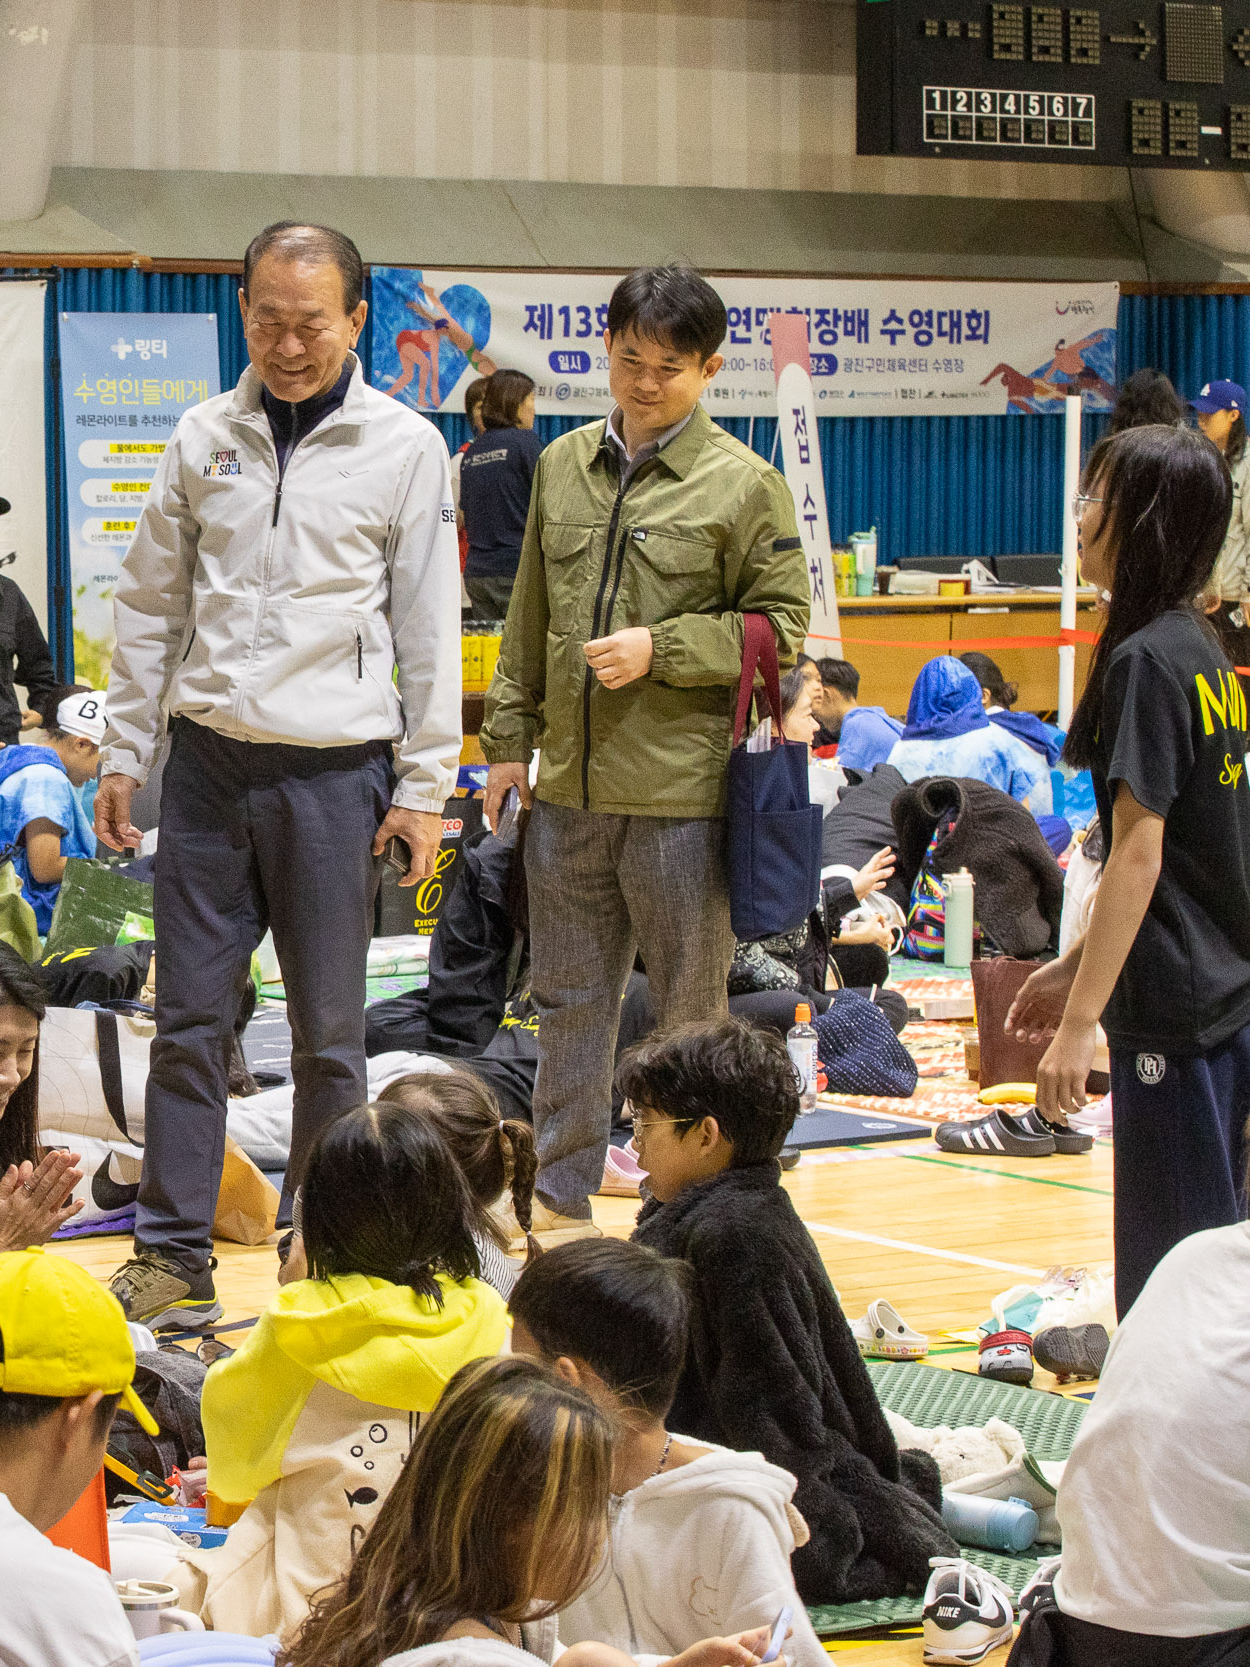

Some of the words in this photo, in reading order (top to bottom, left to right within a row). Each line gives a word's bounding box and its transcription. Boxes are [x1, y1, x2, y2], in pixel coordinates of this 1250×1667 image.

[931, 90, 942, 111] 1
[955, 92, 968, 112] 2
[979, 93, 993, 113] 3
[1003, 94, 1017, 115] 4
[1028, 96, 1040, 116] 5
[1052, 97, 1064, 117] 6
[1075, 98, 1089, 118] 7
[879, 308, 991, 347] 수영대회
[134, 339, 168, 360] 링티
[557, 355, 582, 371] 일시
[932, 358, 965, 374] 수영장
[73, 375, 209, 406] 수영인들에게
[76, 414, 138, 428] 레몬라이트를
[78, 700, 98, 720] B
[936, 1606, 960, 1618] NIKE
